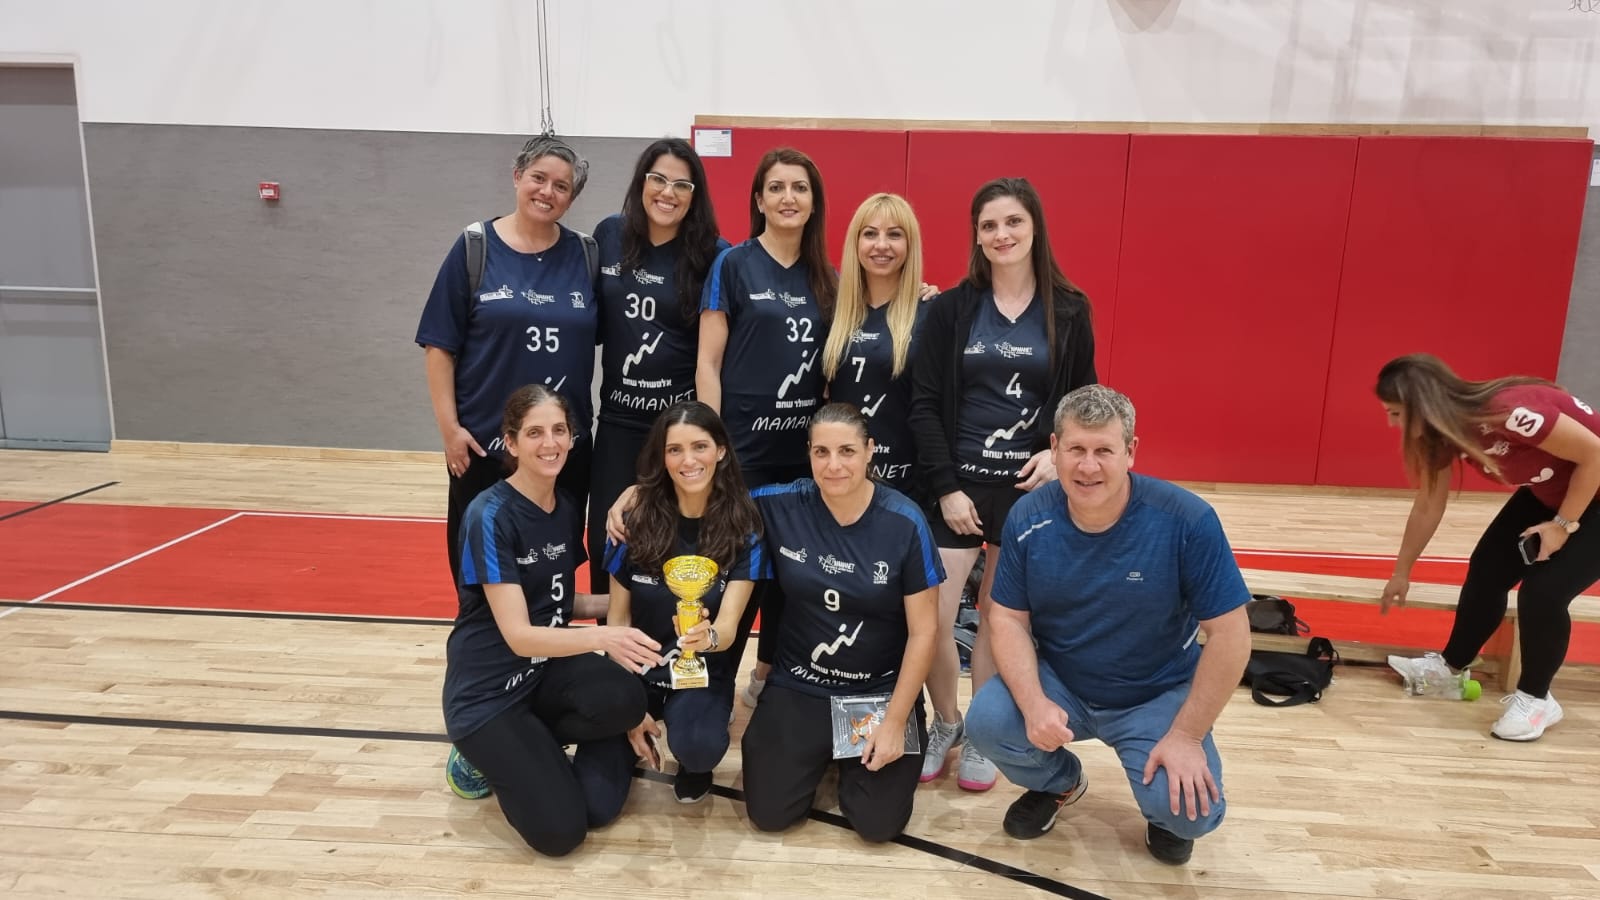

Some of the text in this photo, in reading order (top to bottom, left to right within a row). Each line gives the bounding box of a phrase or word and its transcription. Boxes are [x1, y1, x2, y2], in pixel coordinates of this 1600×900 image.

[624, 292, 656, 321] 30
[525, 326, 560, 353] 35
[785, 316, 815, 343] 32
[852, 356, 866, 383] 7
[1005, 372, 1023, 399] 4
[610, 388, 696, 411] MAMANET
[1004, 449, 1031, 460] טשולר
[872, 463, 912, 479] NET
[550, 572, 564, 602] 5
[823, 588, 841, 612] 9
